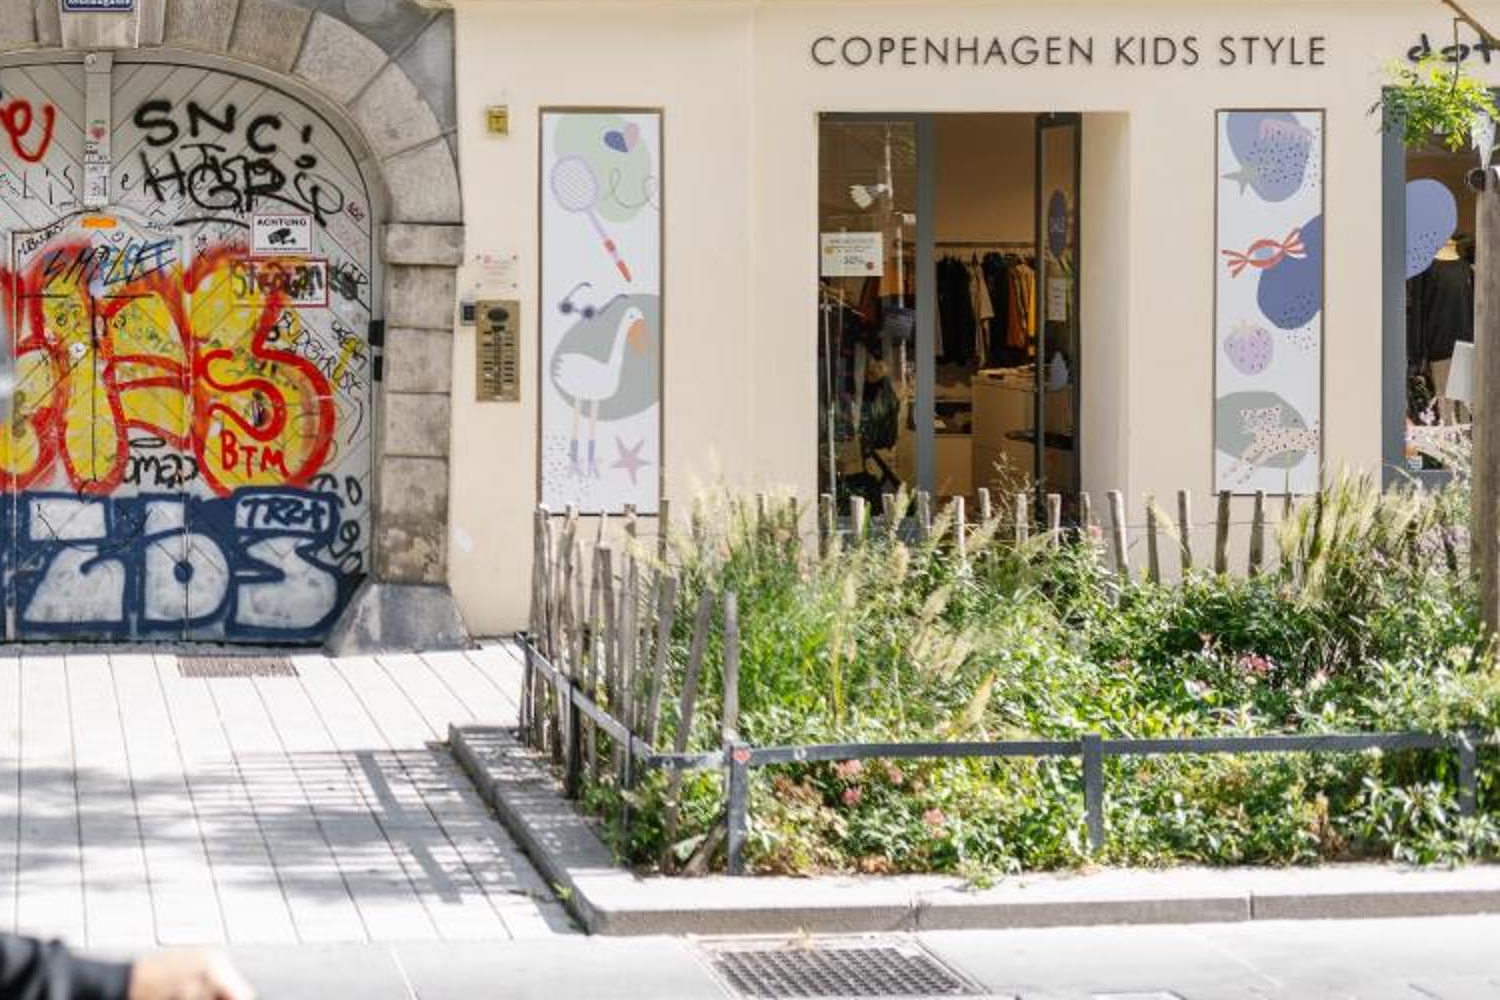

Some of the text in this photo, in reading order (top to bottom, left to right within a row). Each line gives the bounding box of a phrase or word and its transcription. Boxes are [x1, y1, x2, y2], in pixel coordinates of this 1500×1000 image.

[810, 36, 1326, 66] COPENHAGEN KIDS STYLE
[257, 218, 307, 227] ACHTUNG
[222, 430, 291, 478] BTM
